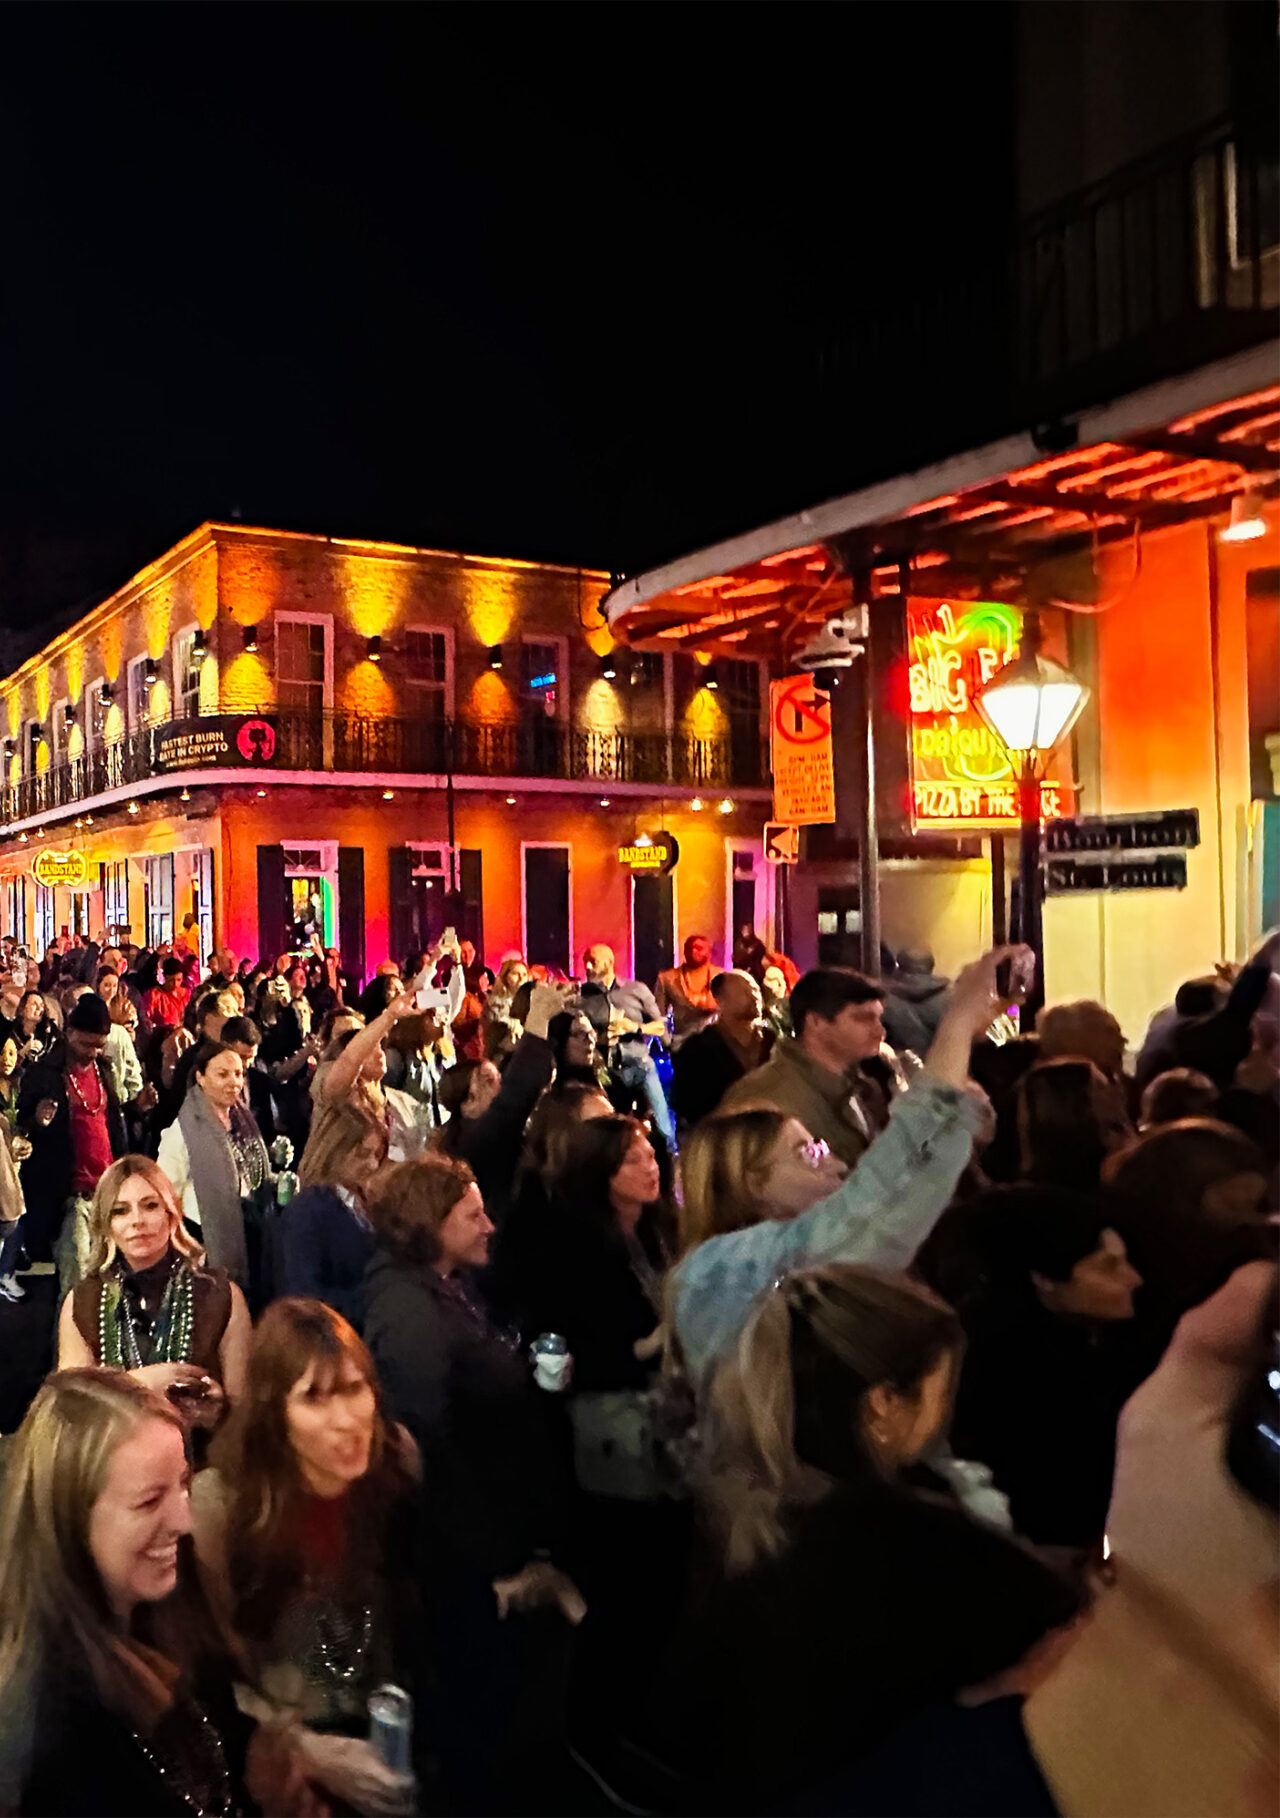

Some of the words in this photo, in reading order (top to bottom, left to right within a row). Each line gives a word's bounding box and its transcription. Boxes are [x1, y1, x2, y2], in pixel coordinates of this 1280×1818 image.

[161, 735, 194, 751] FASTEST
[195, 731, 224, 743] BURN
[177, 747, 187, 757] IN
[187, 742, 229, 756] CRYPTO
[960, 787, 980, 816] BY
